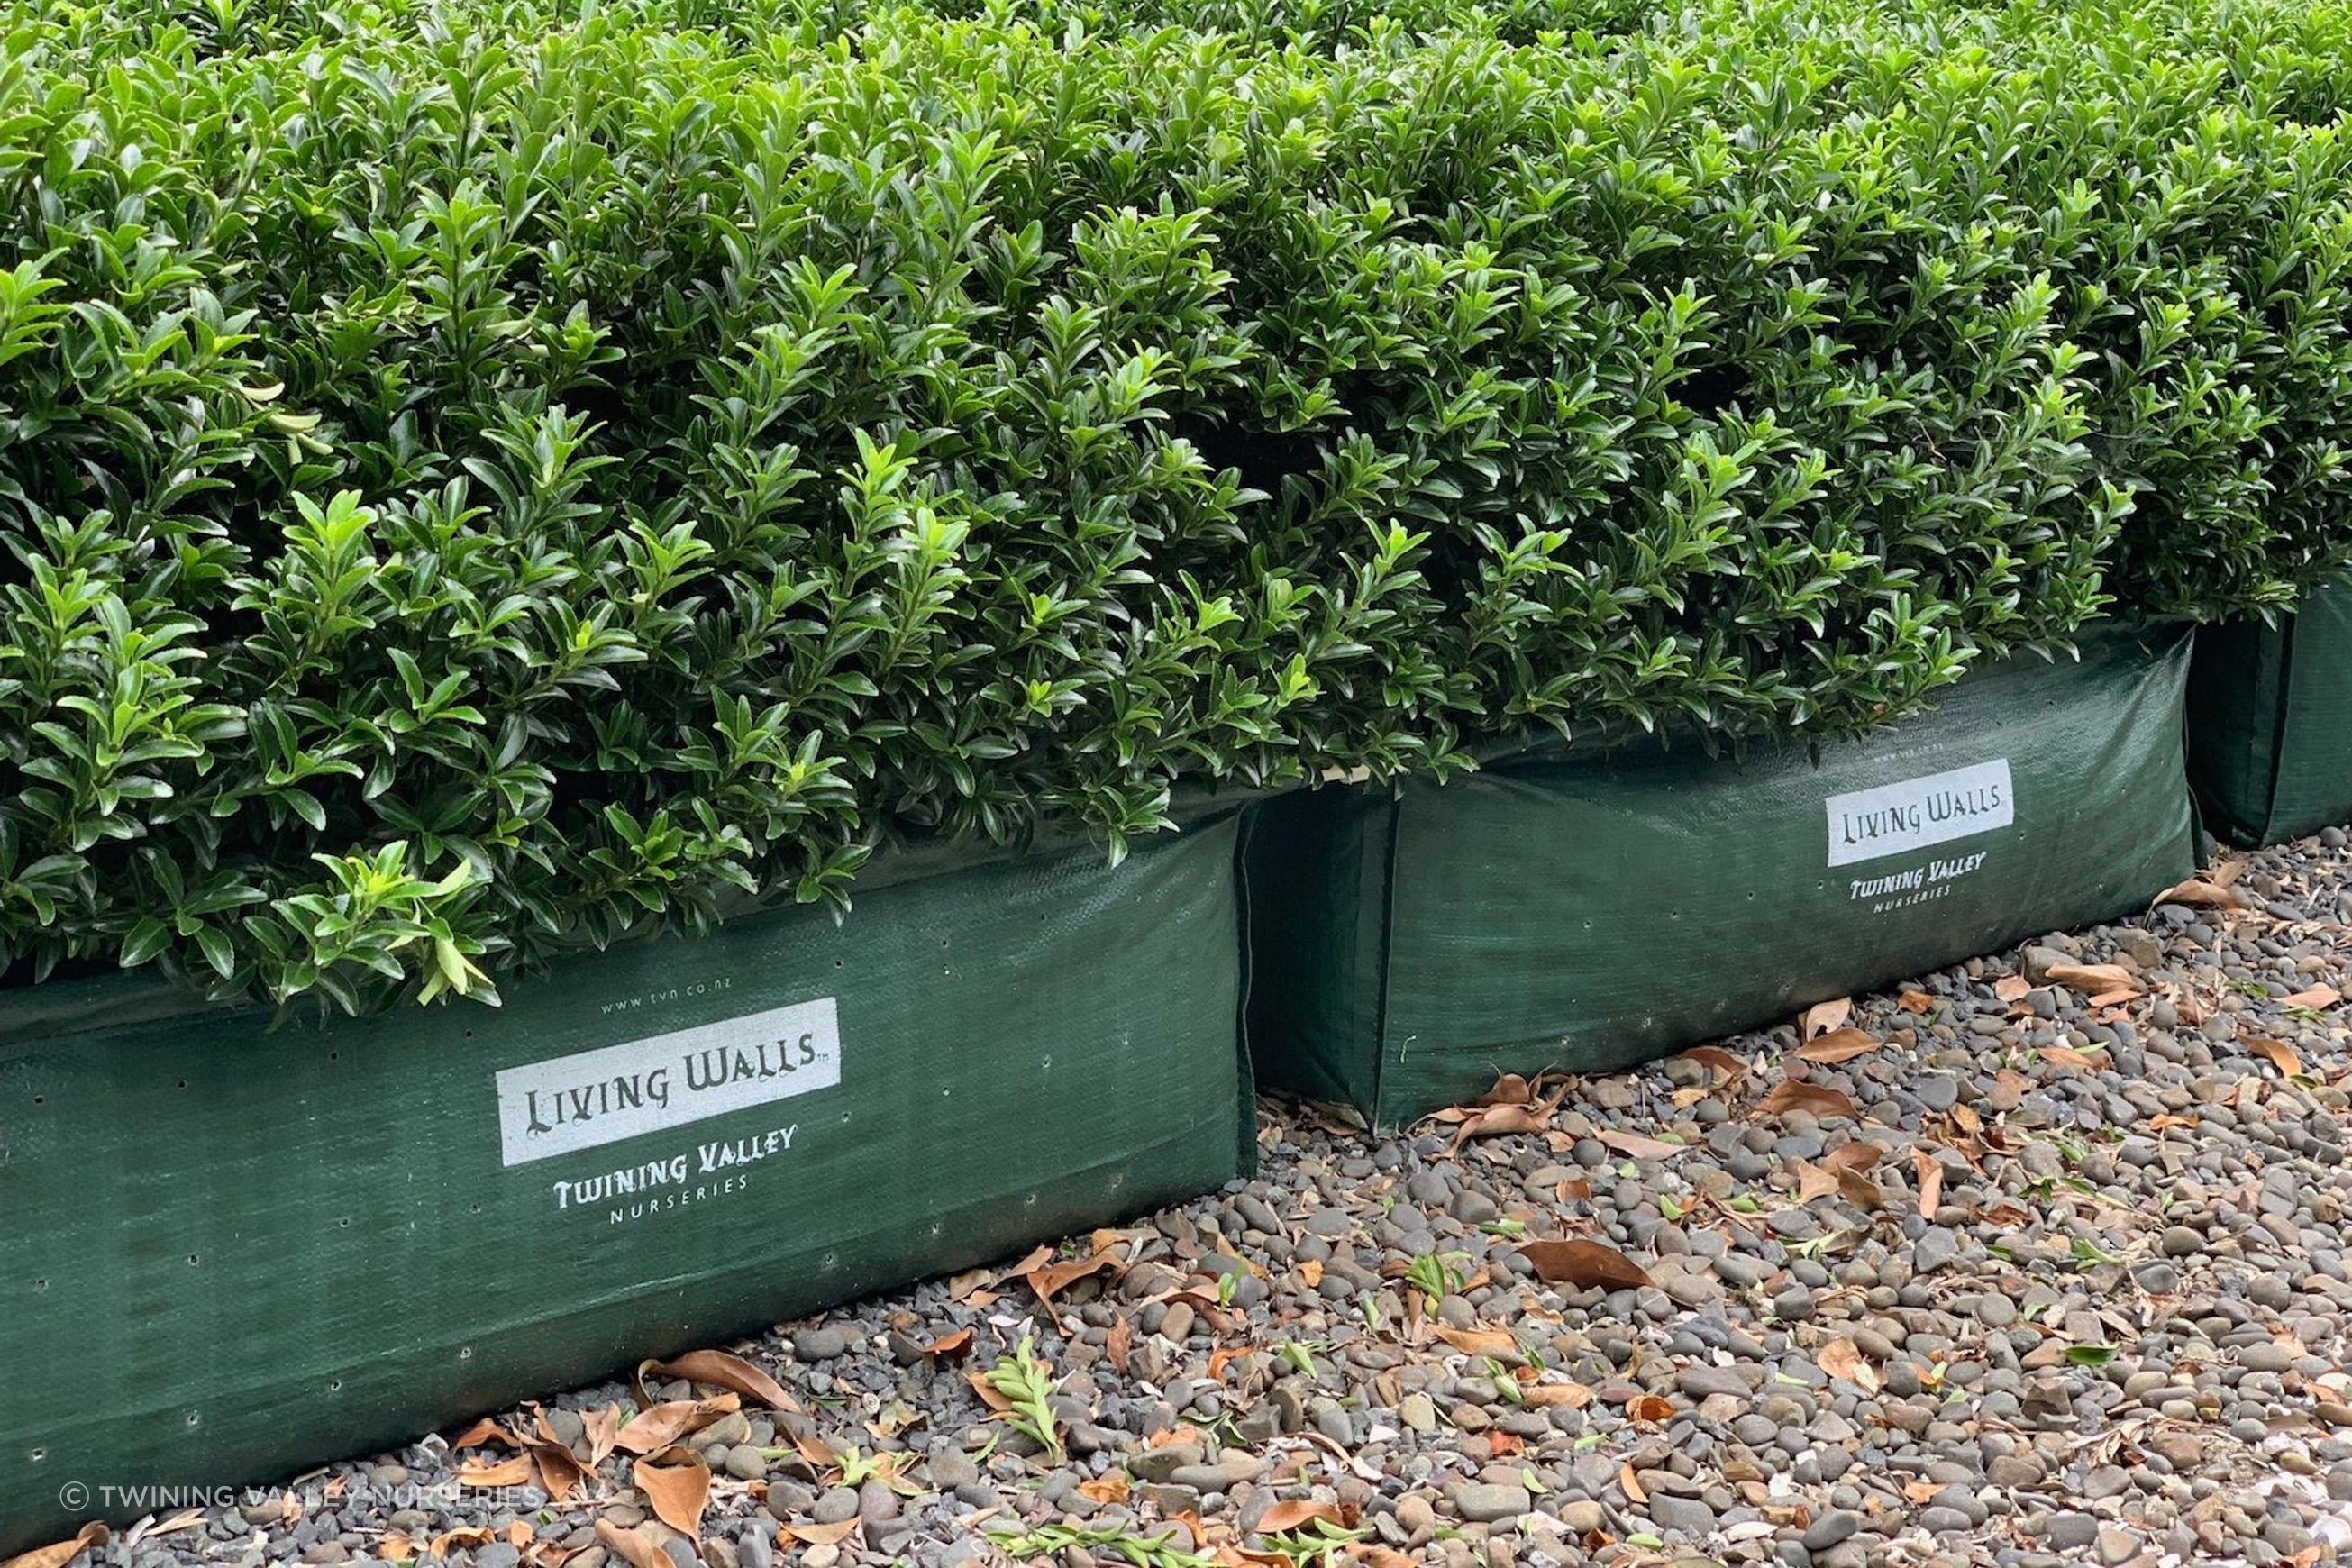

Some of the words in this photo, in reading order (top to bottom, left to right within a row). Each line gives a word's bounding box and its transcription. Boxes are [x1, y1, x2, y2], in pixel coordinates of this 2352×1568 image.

[1843, 803, 1920, 844] LIVING
[1926, 784, 2001, 822] WALLS
[1849, 867, 1925, 900] TWINING
[1927, 851, 1987, 886] VALLEY
[1873, 884, 1951, 914] NURSERIES
[600, 977, 732, 1015] wwwtvnco.nz
[524, 1066, 670, 1140] LIVING
[552, 1153, 688, 1209] TWINING
[697, 1123, 799, 1175] VALLEY
[609, 1174, 748, 1226] NURSERIES
